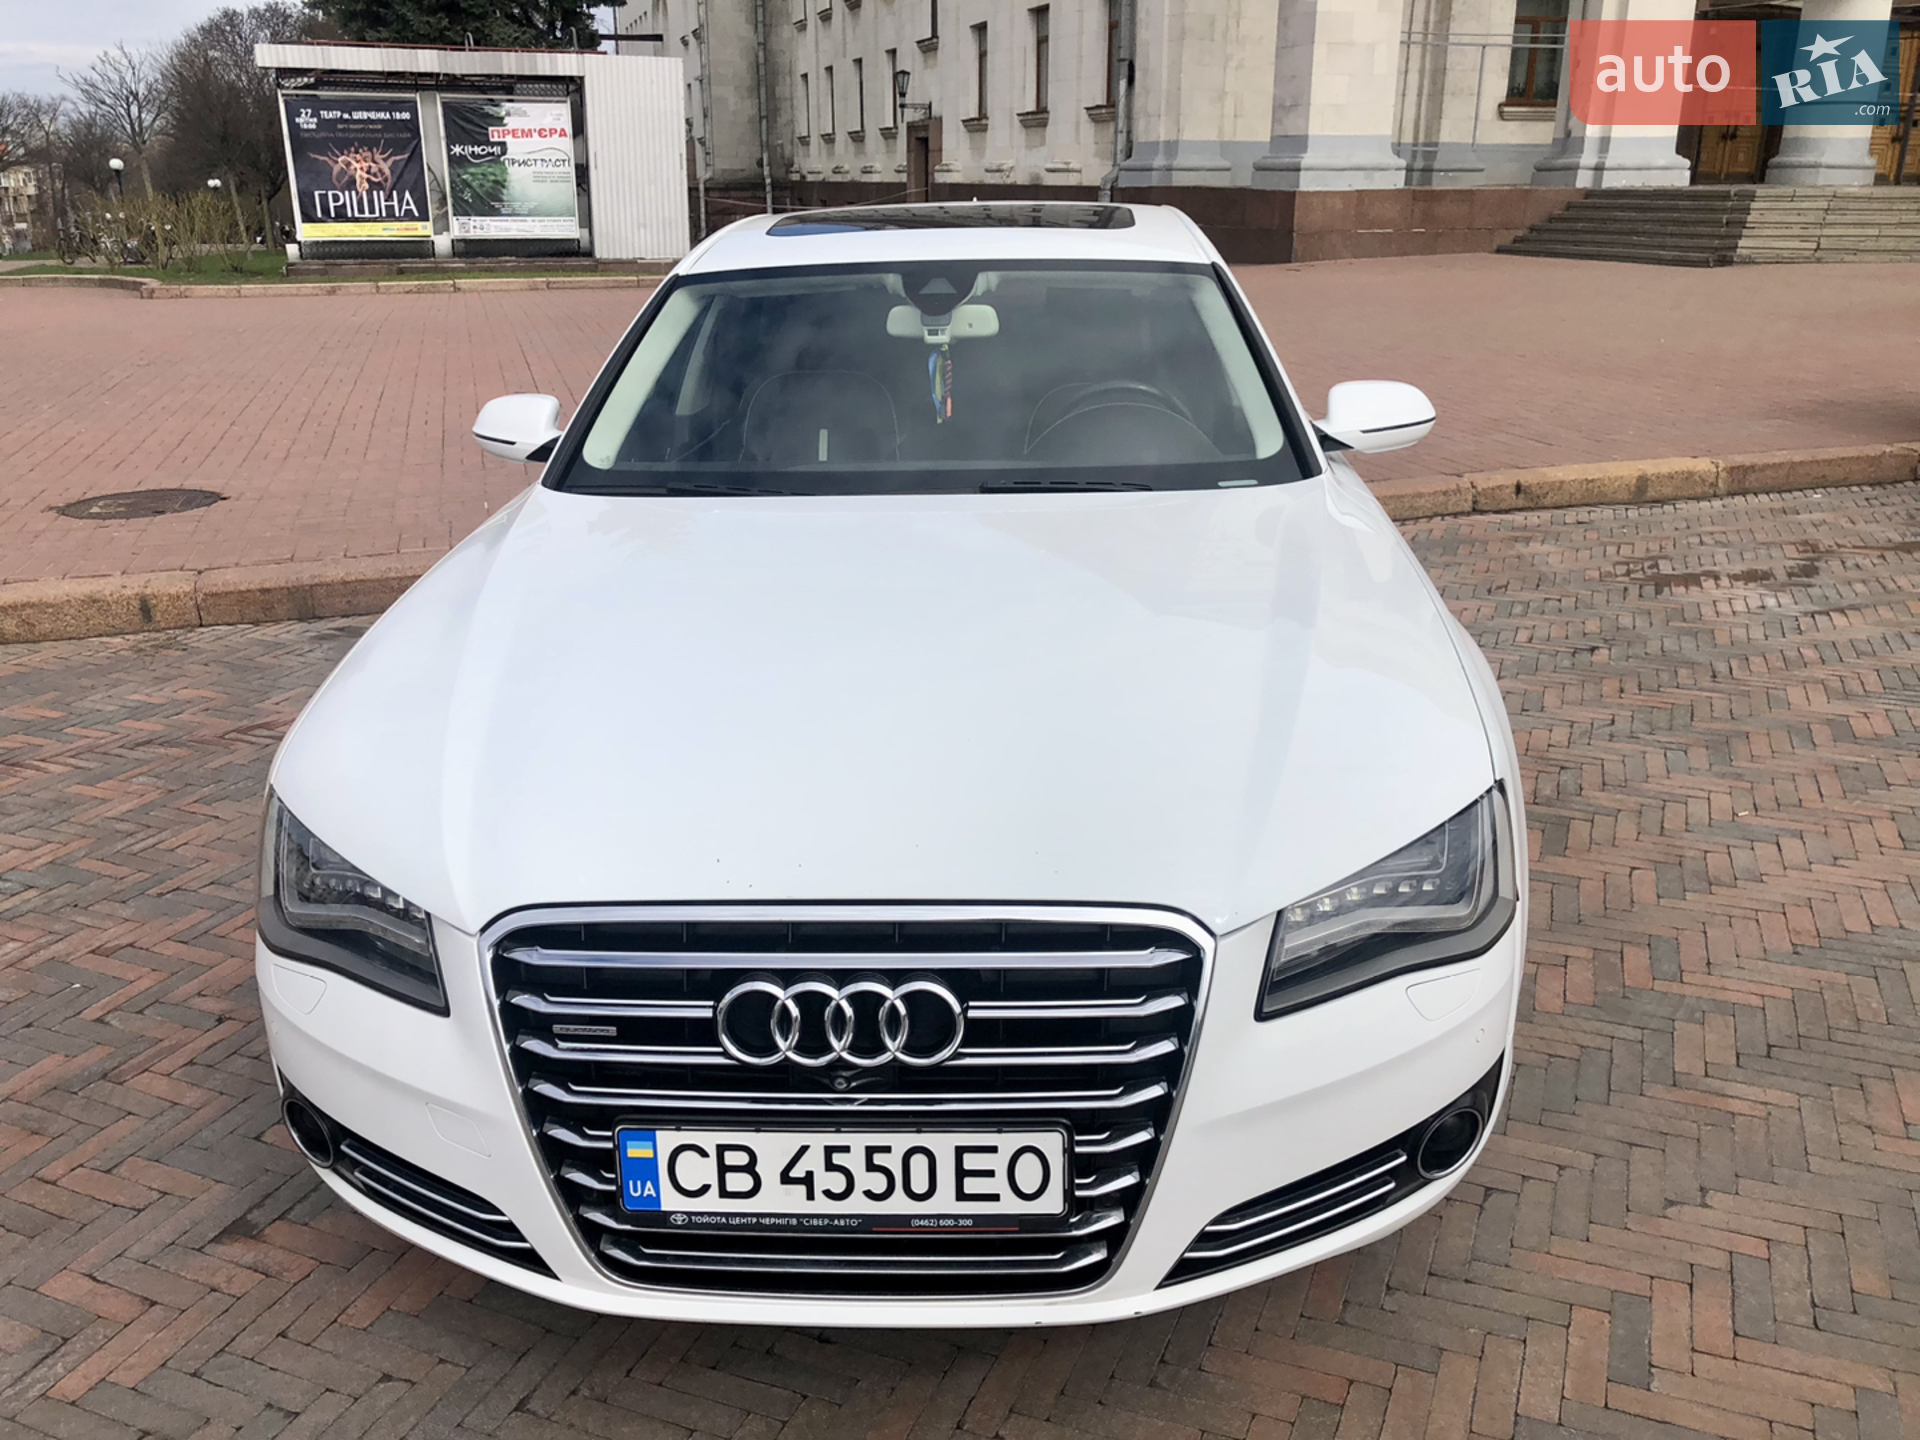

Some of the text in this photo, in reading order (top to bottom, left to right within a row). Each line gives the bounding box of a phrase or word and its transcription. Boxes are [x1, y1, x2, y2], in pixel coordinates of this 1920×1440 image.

[299, 108, 312, 118] 27
[320, 110, 341, 119] ТЕАТР
[352, 111, 391, 120] ШЕВЧЕНКА
[392, 111, 411, 120] 18:00
[490, 127, 568, 139] ПРЕМ'ЄРА
[502, 157, 571, 168] ПРИСТРАСТІ
[314, 190, 419, 218] ГРІШНА
[629, 1180, 656, 1197] UA
[691, 1214, 727, 1224] ТОЙОТА
[729, 1217, 757, 1226] ЦЕНТР
[759, 1217, 797, 1226] ЧЕРНІГІВ
[911, 1218, 973, 1227] (0462) 600-300
